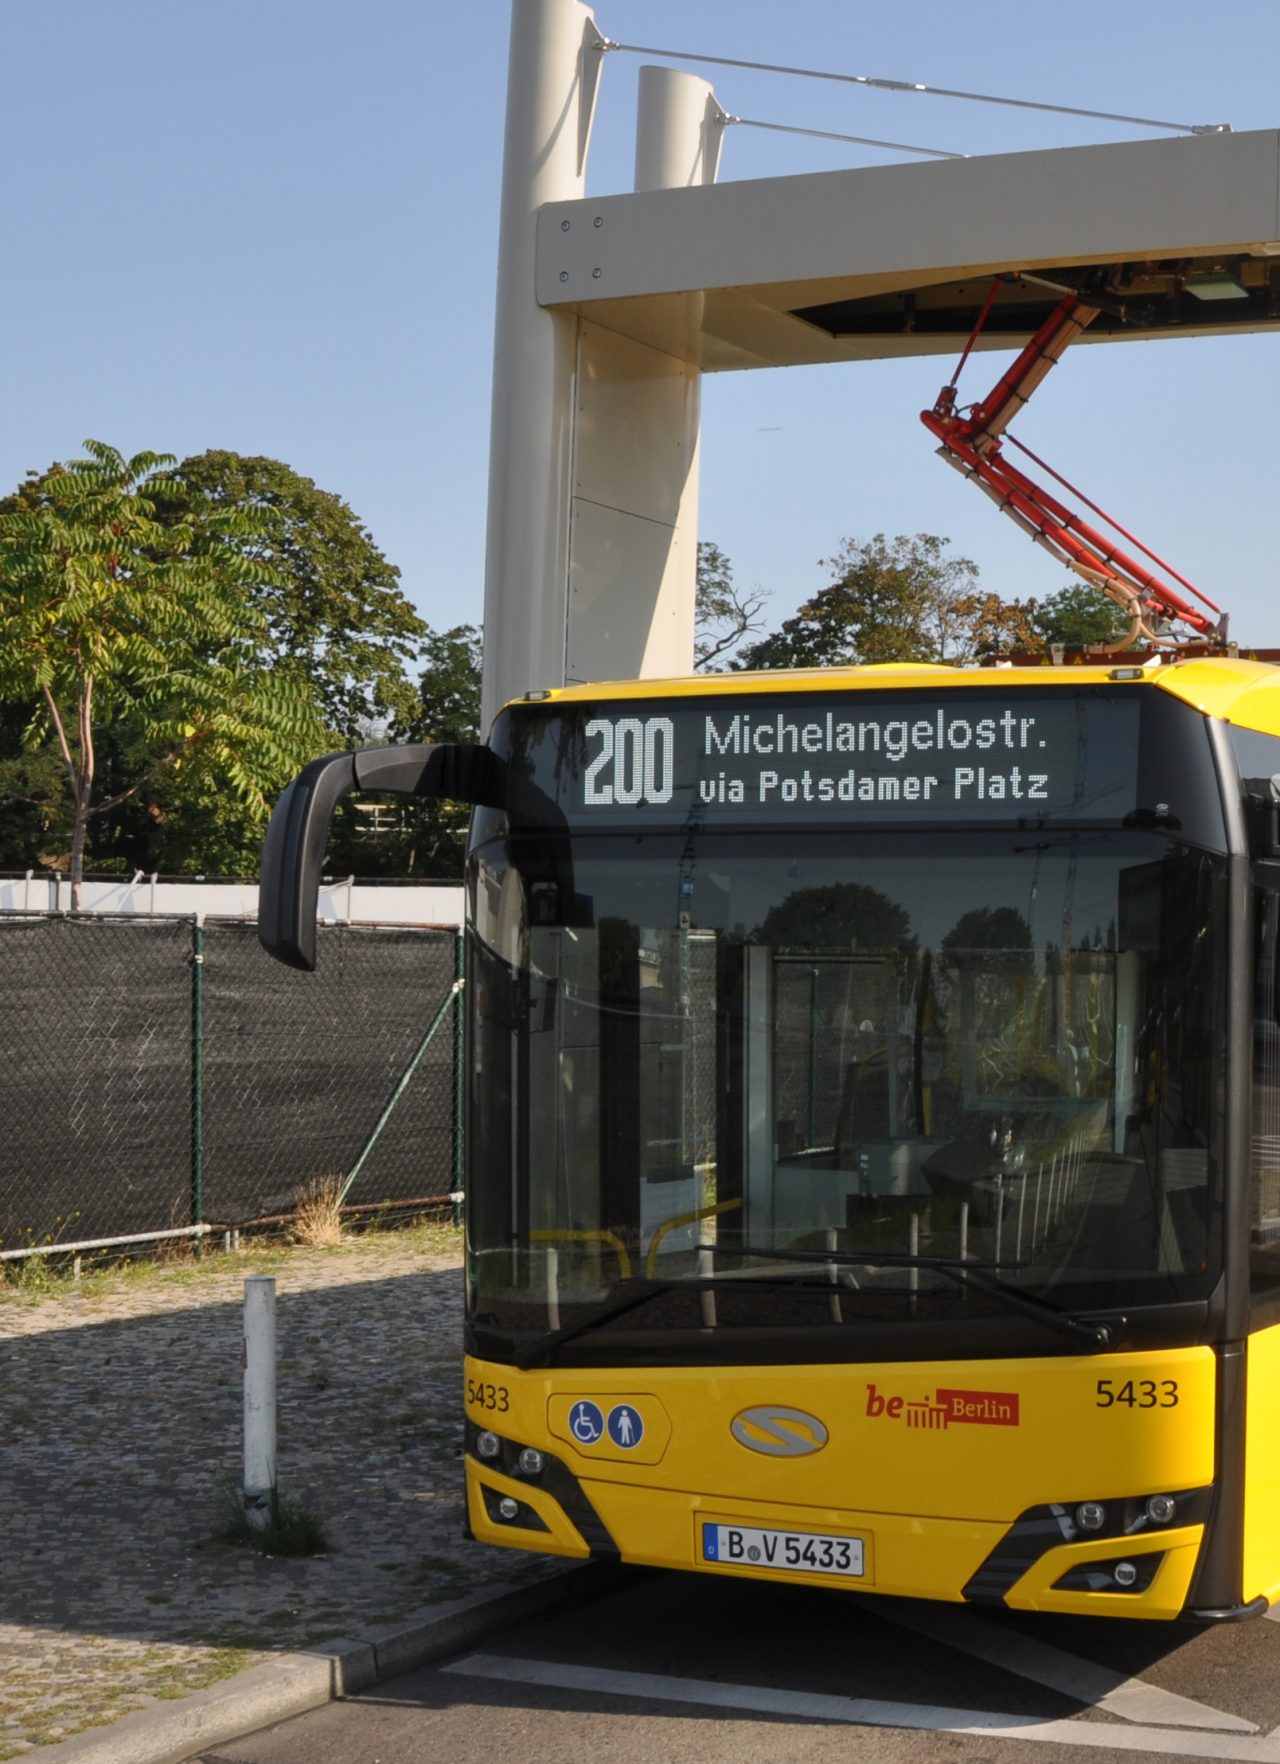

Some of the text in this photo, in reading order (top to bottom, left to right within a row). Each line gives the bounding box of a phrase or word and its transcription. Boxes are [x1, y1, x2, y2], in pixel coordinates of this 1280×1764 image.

[705, 709, 1046, 761] Michelangelostr.
[584, 717, 674, 804] 200
[700, 766, 1048, 803] via Potsdamer Platz
[468, 1379, 509, 1412] 5433
[866, 1384, 1011, 1420] be Berlin
[1095, 1380, 1179, 1408] 5433
[729, 1531, 851, 1569] B V 5433
